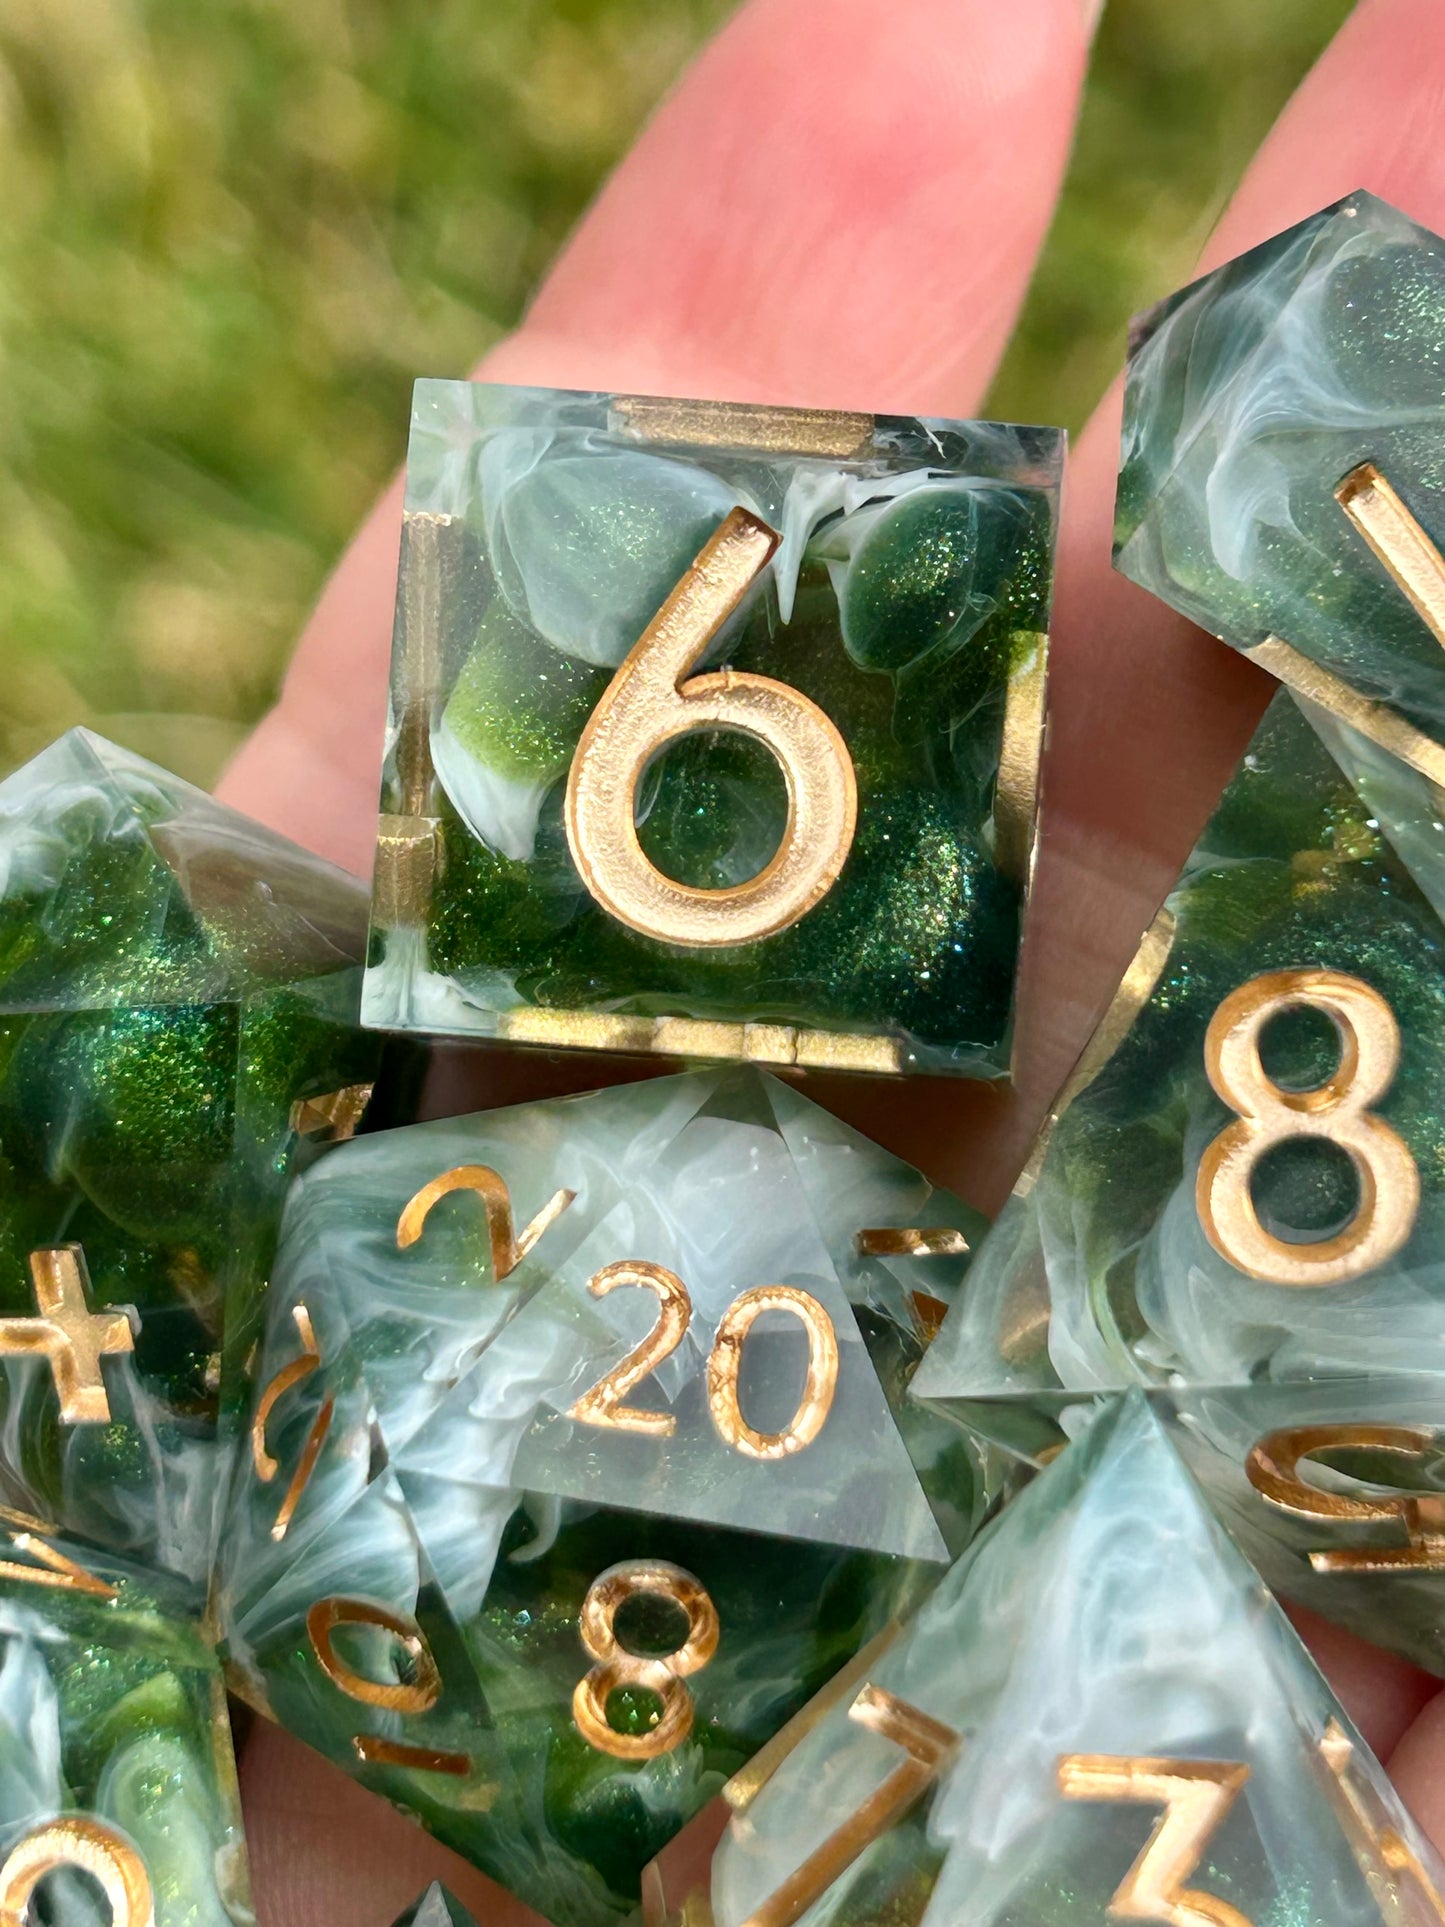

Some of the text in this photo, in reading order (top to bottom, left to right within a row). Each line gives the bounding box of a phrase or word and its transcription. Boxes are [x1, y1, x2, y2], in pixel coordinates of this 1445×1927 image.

[566, 506, 857, 948] 6
[1195, 966, 1420, 1288] 8
[566, 1259, 839, 1460] 20
[572, 1559, 719, 1759] 8
